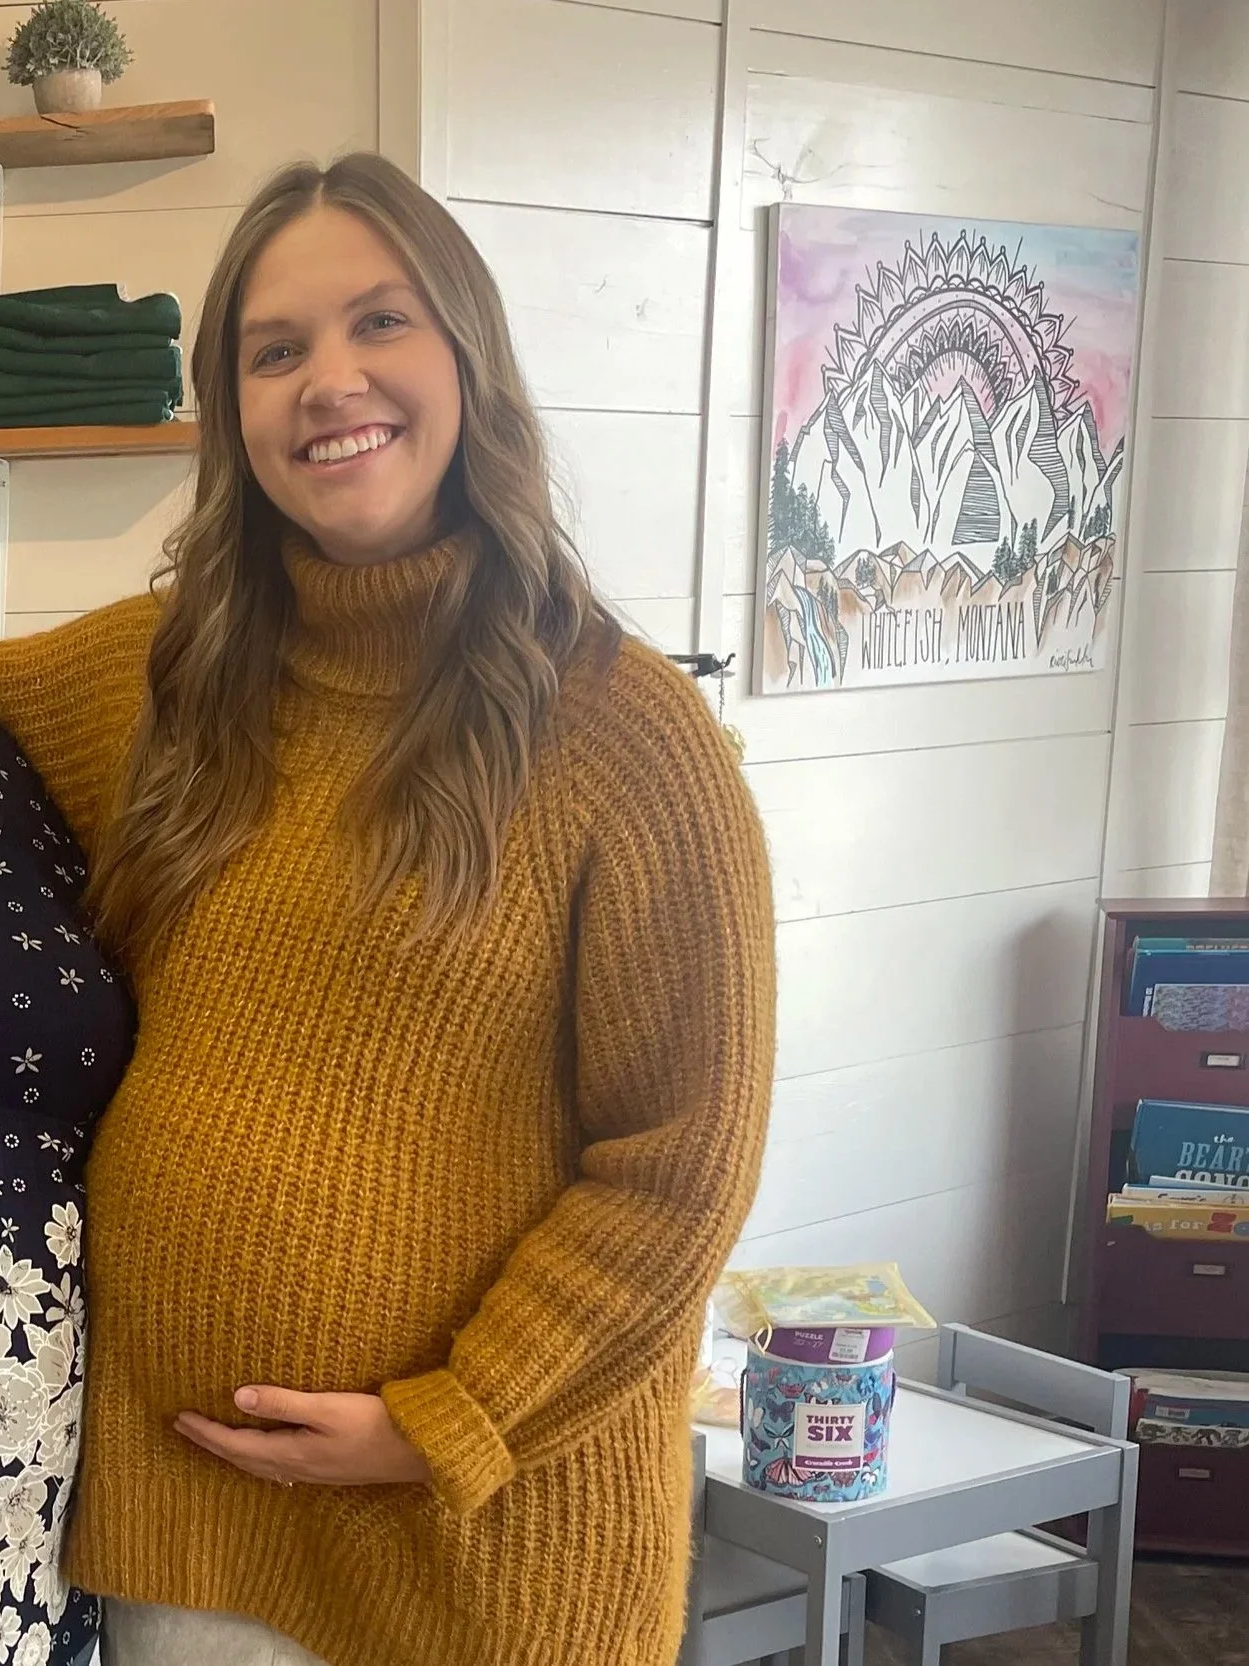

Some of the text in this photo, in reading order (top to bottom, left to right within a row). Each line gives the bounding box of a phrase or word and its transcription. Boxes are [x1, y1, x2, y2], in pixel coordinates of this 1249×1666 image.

[860, 607, 950, 670] WHITEFISH,
[956, 601, 1027, 663] MONTANA
[1177, 1141, 1249, 1172] BEAR
[1170, 1219, 1203, 1231] for
[794, 1330, 824, 1341] PUZZLE
[806, 1415, 855, 1425] THIRTY
[807, 1425, 853, 1442] SIX
